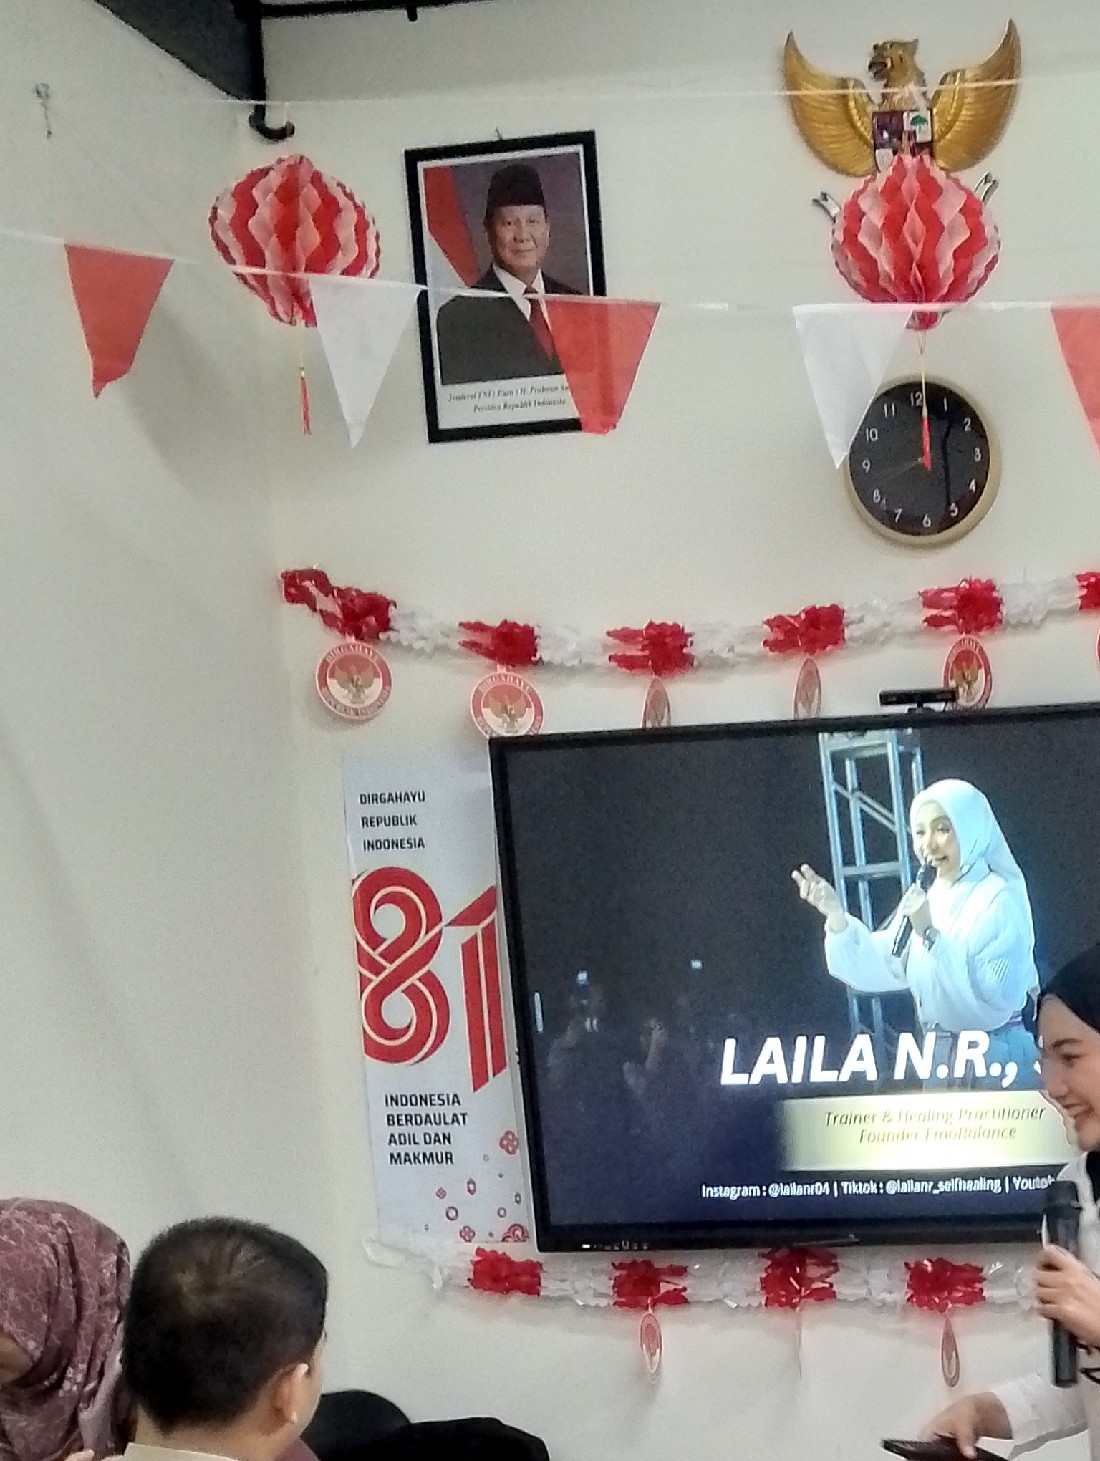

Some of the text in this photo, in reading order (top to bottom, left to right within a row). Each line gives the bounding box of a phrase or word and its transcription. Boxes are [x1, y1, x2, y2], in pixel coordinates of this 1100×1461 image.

[910, 391, 923, 407] 12
[884, 401, 895, 418] 11
[963, 417, 972, 431] 2
[866, 427, 878, 442] 10
[862, 460, 871, 473] 9
[873, 488, 881, 503] 8
[922, 513, 932, 527] 6
[360, 790, 426, 805] DIRGAHAYU
[361, 814, 417, 828] REPUBLIK
[363, 837, 426, 852] INDONESIA
[720, 1030, 1018, 1087] LAILA N.R.,
[385, 1093, 461, 1107] INDONESIA
[386, 1112, 468, 1127] BERDAULAT
[825, 1110, 877, 1127] Trainer
[959, 1105, 1046, 1123] Practitioner
[388, 1132, 452, 1146] ADIL DAN
[859, 1127, 919, 1144] Founder
[389, 1151, 454, 1165] MAKMUR
[702, 1184, 761, 1201] Instagram
[841, 1179, 878, 1195] Tiktok
